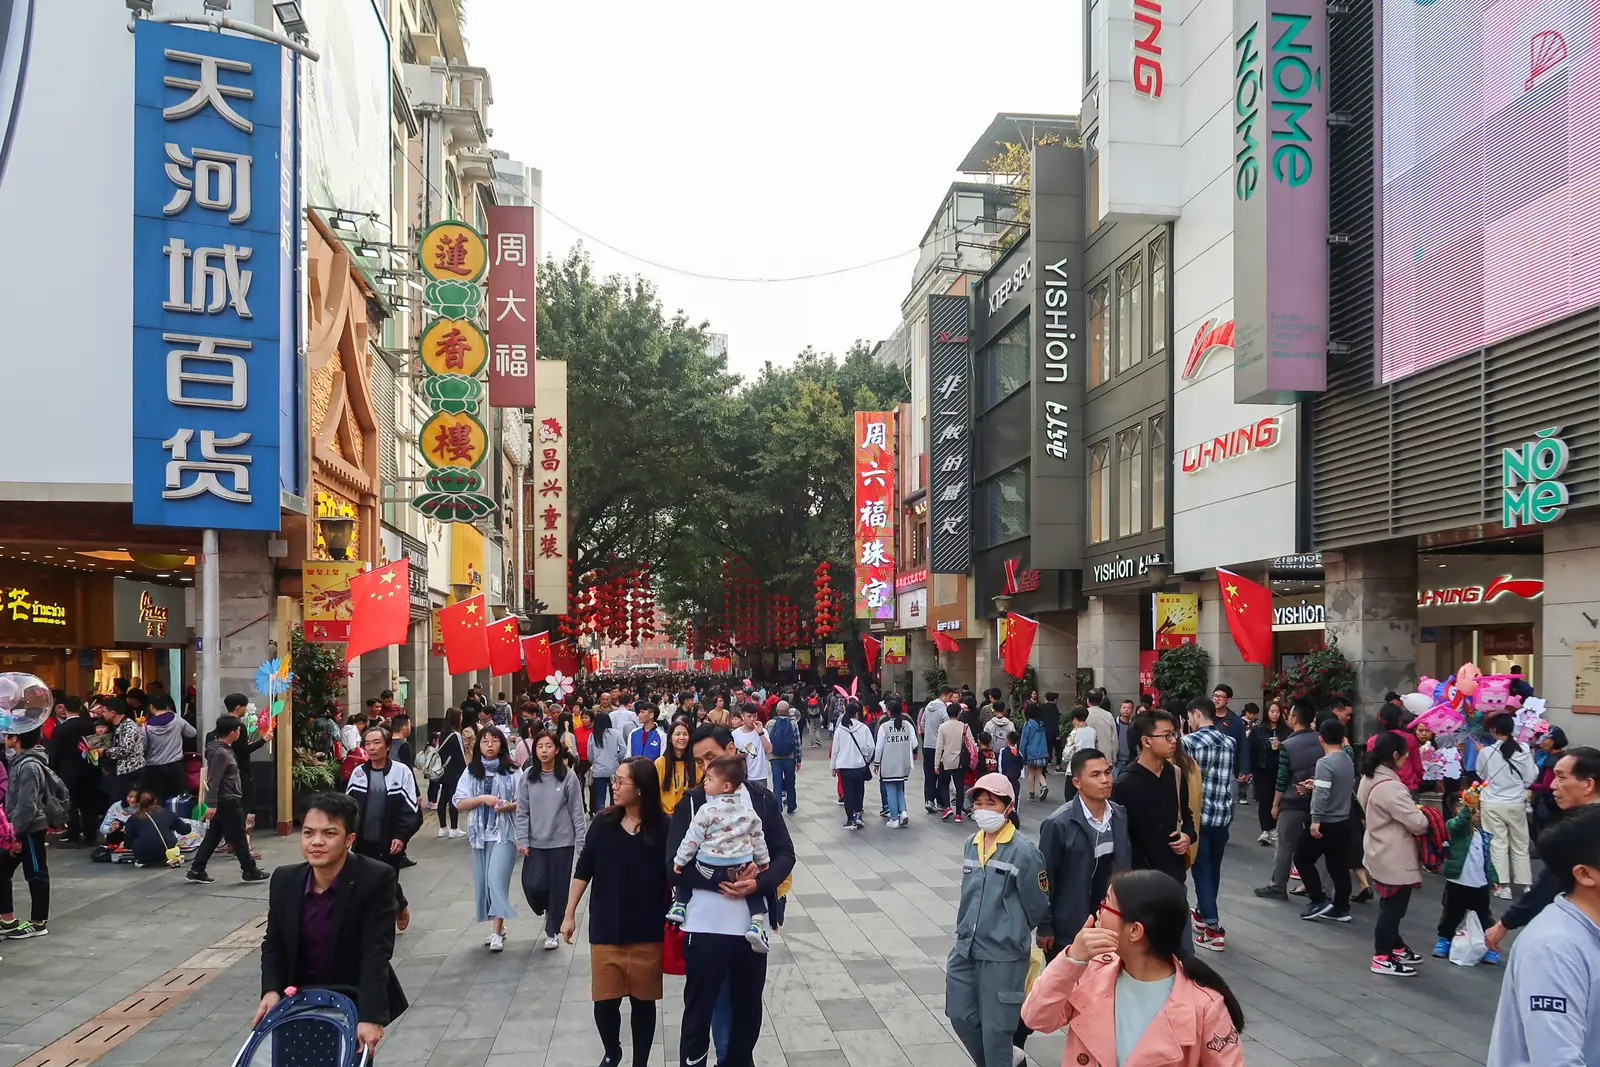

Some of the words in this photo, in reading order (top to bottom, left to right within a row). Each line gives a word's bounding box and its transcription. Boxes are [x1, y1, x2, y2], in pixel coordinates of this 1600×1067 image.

[162, 47, 254, 503] 天河城百货
[495, 232, 528, 379] 周大福
[988, 278, 1012, 317] XTEP
[432, 233, 475, 462] 蓮香樓
[538, 447, 564, 560] 昌兴童装
[938, 373, 964, 535] 非一般的感觉
[1182, 416, 1279, 473] LI-NING
[861, 422, 890, 609] 周六福珠宝
[886, 735, 909, 743] CREAM
[1531, 997, 1565, 1011] HFQ
